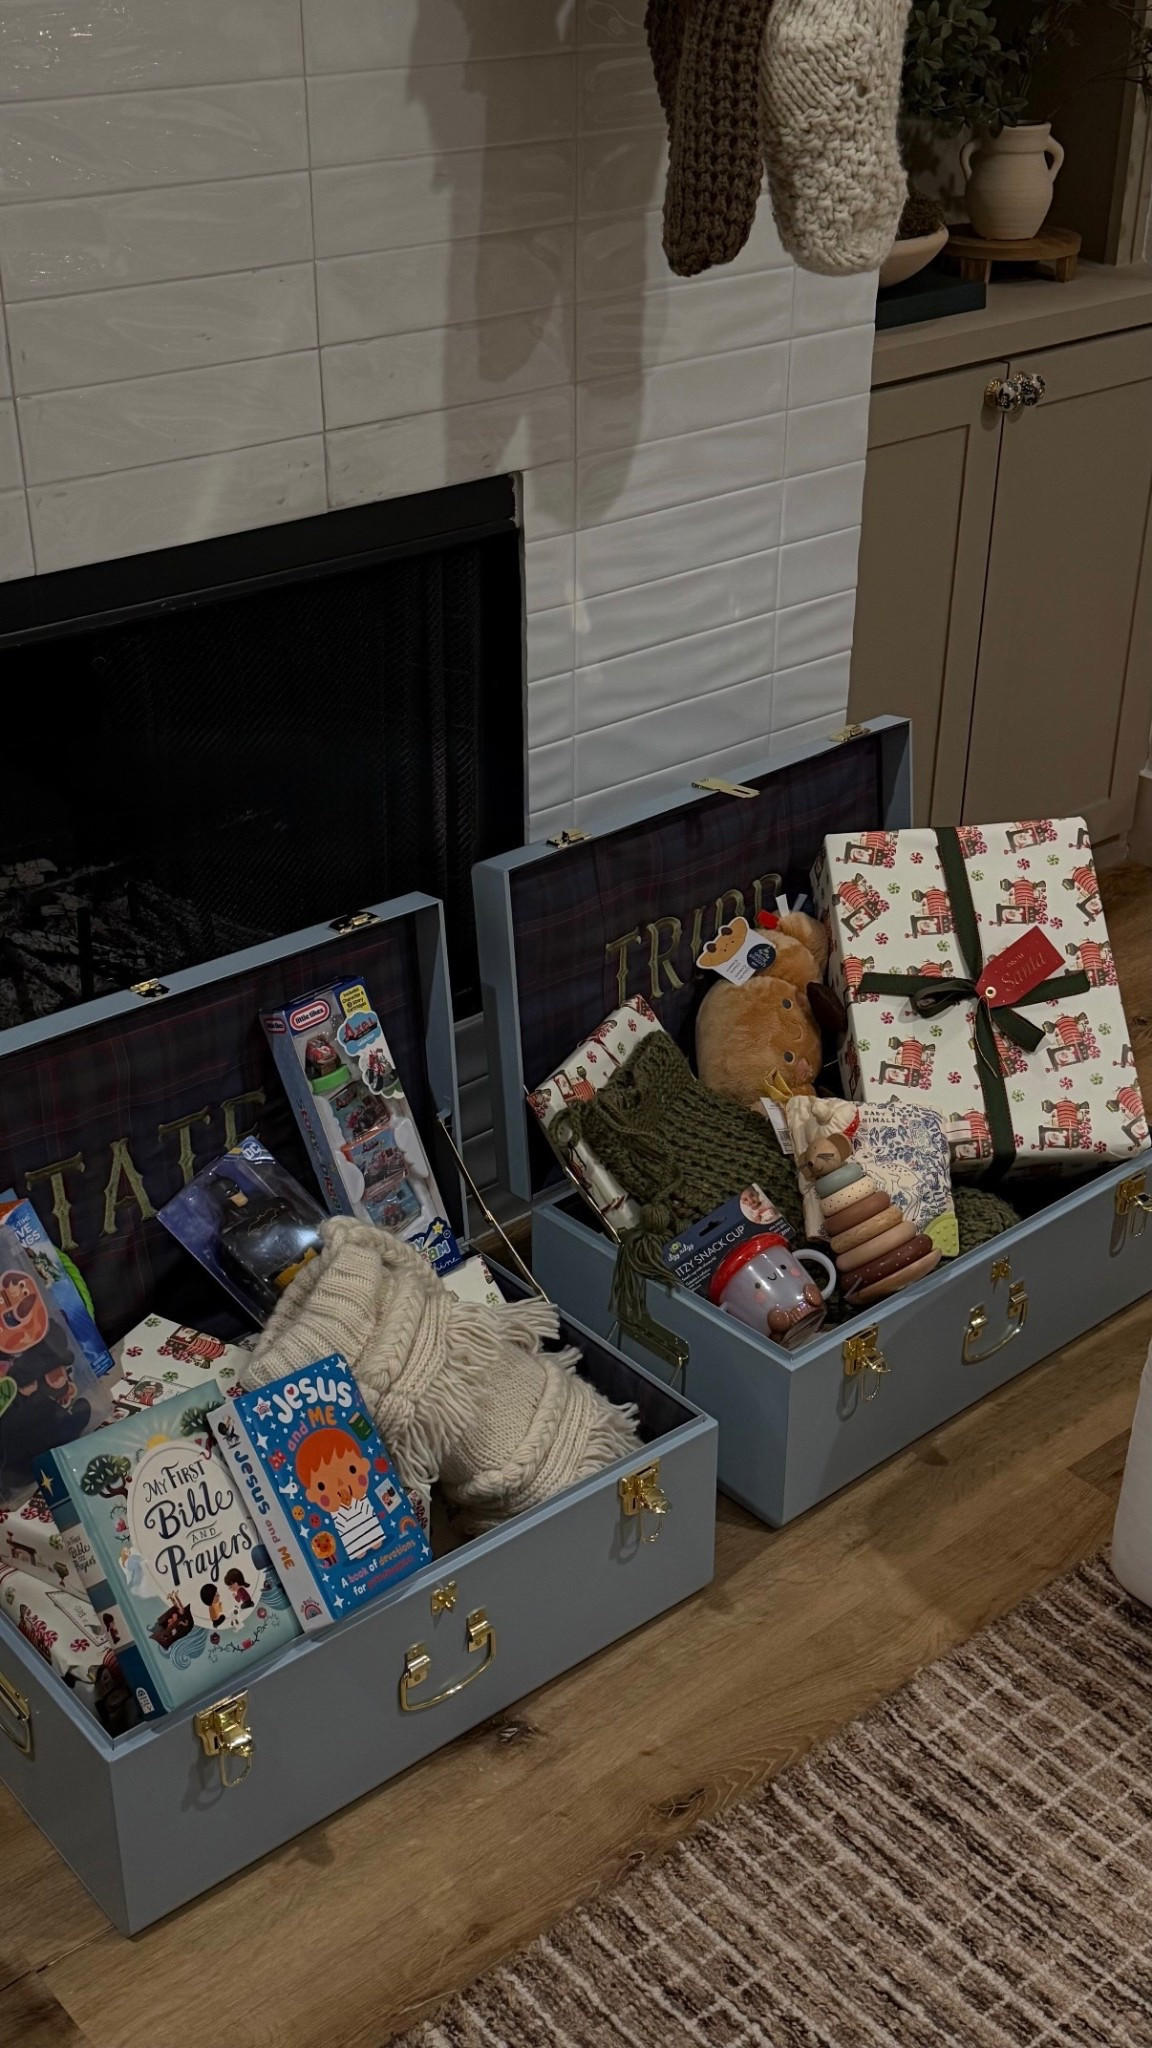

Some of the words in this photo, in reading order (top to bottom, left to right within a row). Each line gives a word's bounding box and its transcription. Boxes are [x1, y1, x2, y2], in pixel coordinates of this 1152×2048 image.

[1001, 952, 1046, 992] Santa
[295, 1014, 309, 1024] little
[309, 1008, 324, 1020] tikes
[675, 1259, 695, 1277] ITZY
[694, 1238, 728, 1262] SNACK
[725, 1225, 745, 1243] CUP
[272, 1376, 352, 1424] Jesus
[287, 1423, 308, 1451] and
[306, 1405, 337, 1427] ME
[144, 1490, 234, 1540] Bible
[234, 1451, 271, 1516] Jesus
[266, 1520, 281, 1544] and
[277, 1547, 295, 1571] ME
[155, 1523, 252, 1587] Prayers
[191, 1527, 217, 1543] AND
[341, 1577, 349, 1589] A
[347, 1567, 369, 1584] book
[369, 1558, 378, 1572] of
[353, 1583, 366, 1596] for
